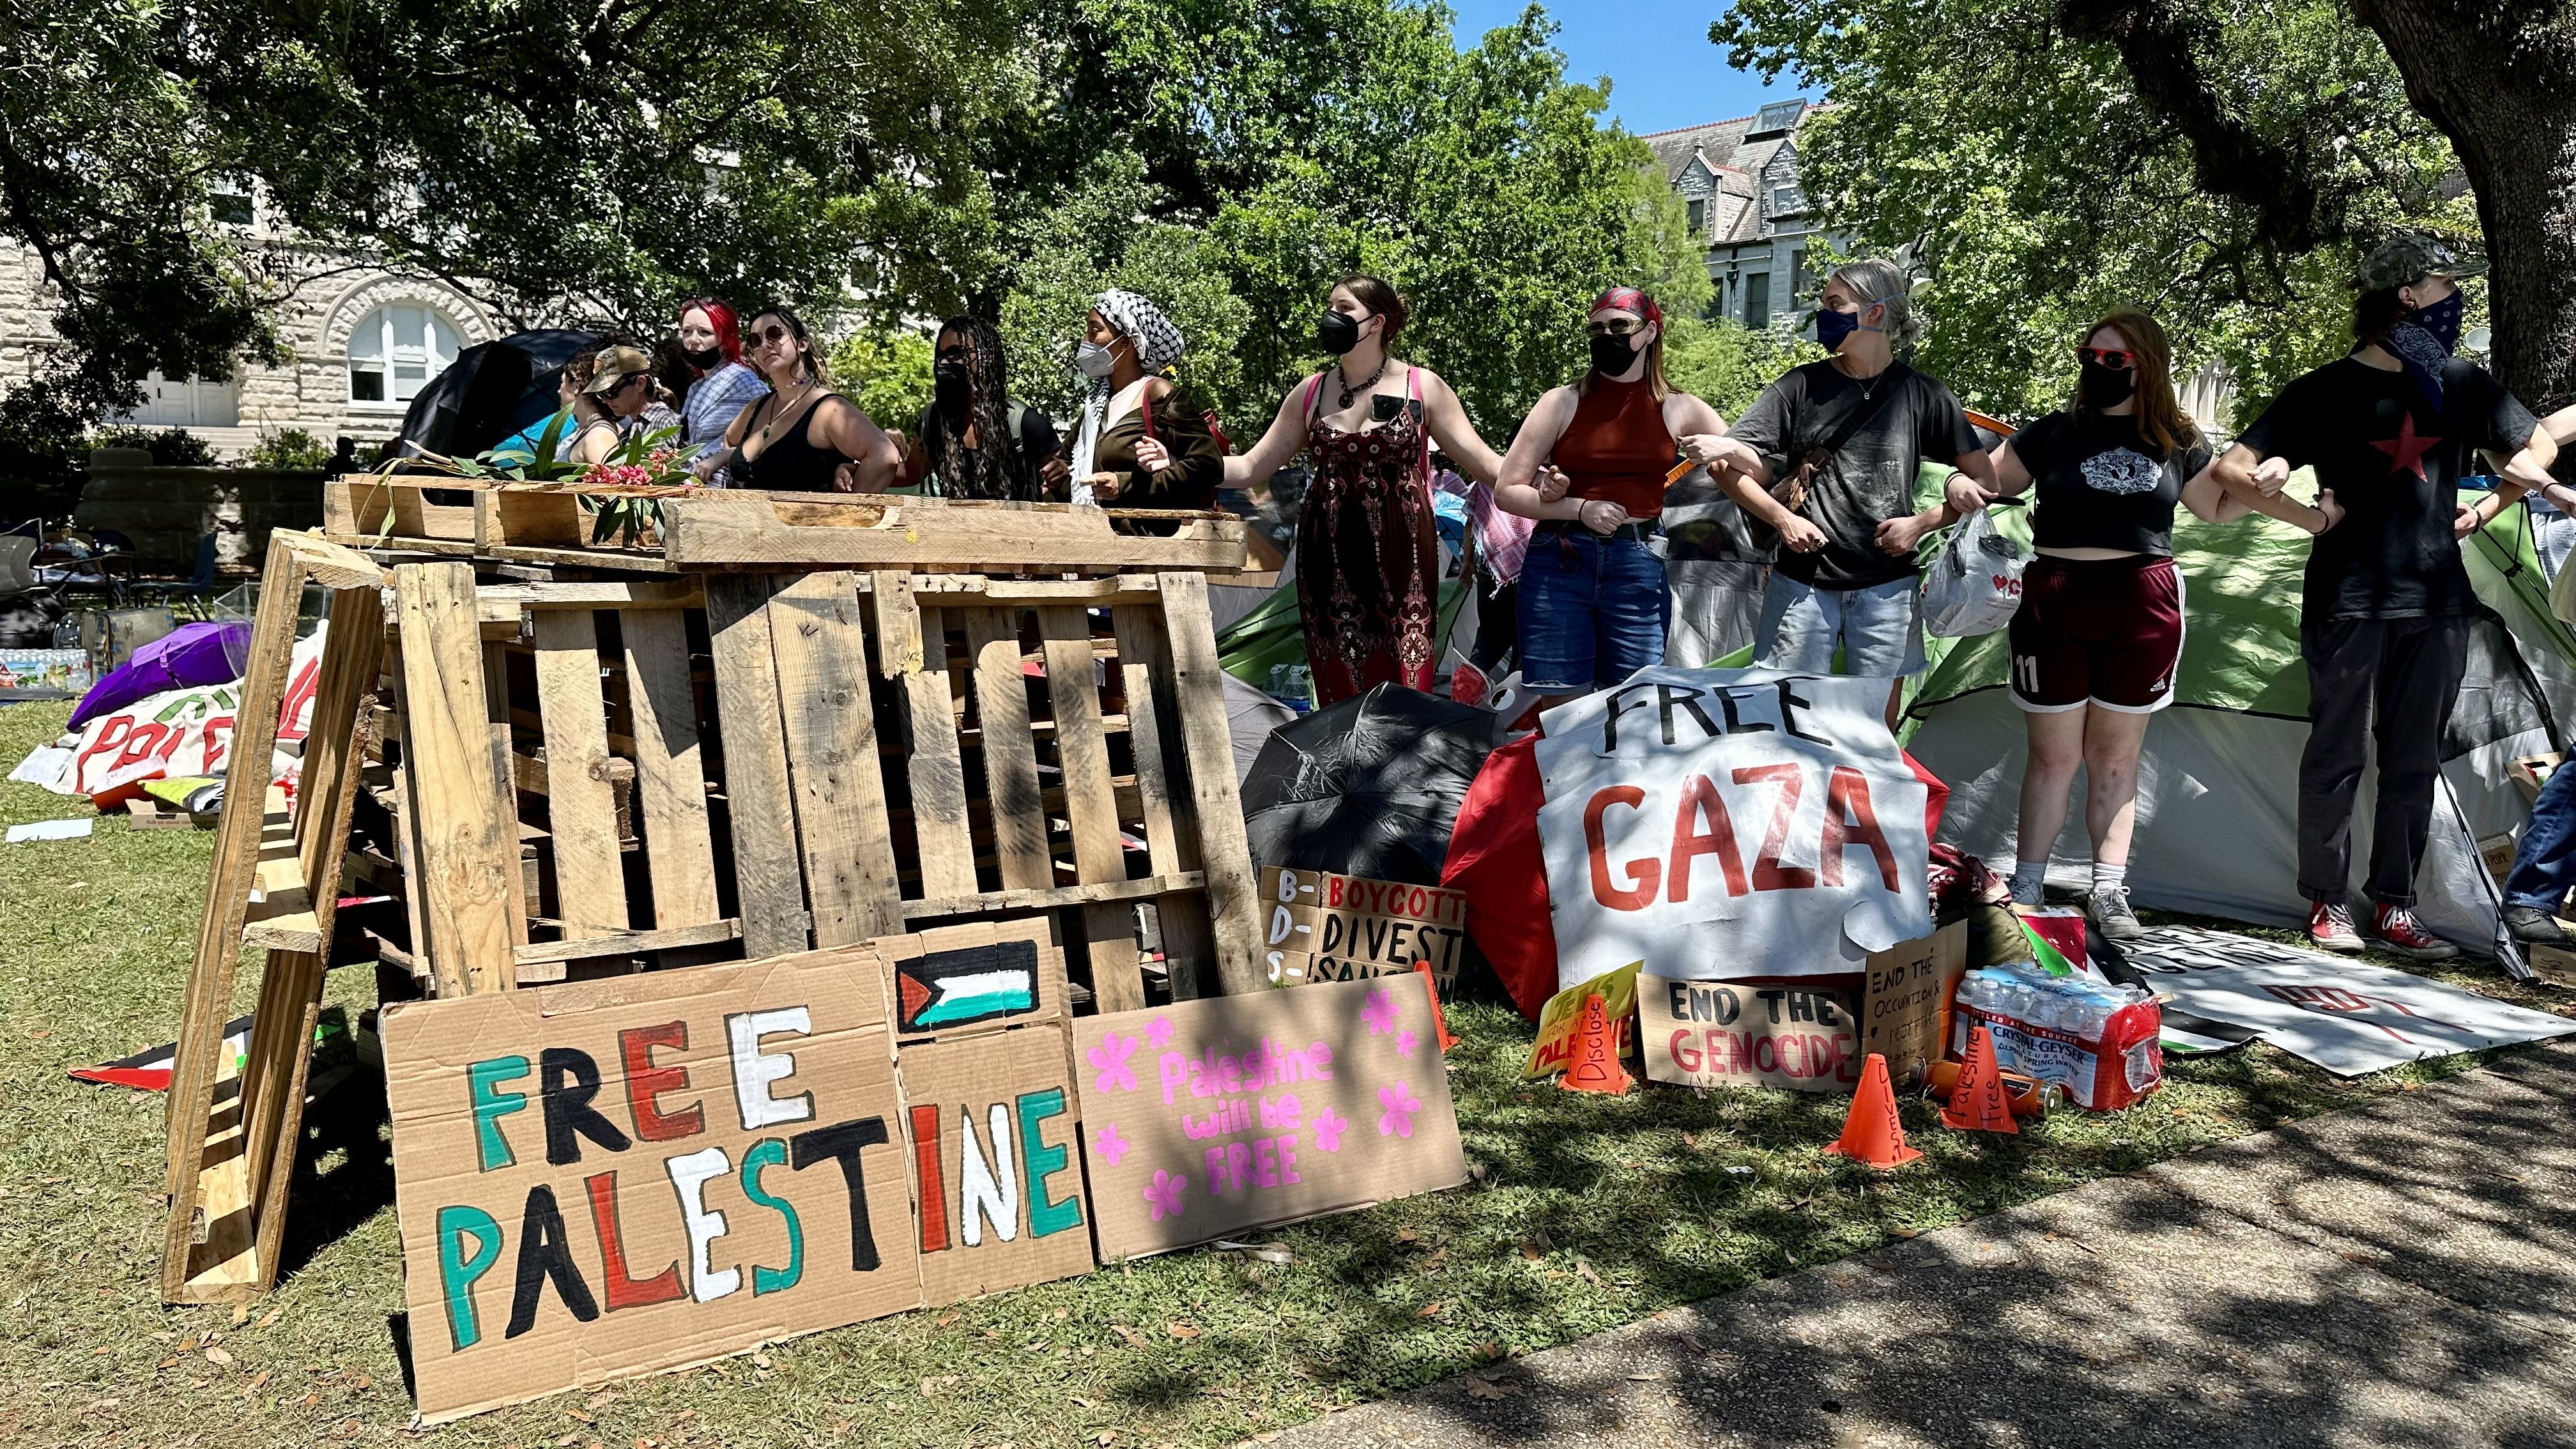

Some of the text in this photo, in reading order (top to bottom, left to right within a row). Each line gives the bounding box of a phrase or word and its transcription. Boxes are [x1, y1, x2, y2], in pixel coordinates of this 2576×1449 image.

[2016, 654, 2040, 693] 11
[1604, 676, 1834, 753] FREE
[1584, 763, 1901, 912] GAZA
[1330, 877, 1466, 923] BOYCOTT
[1322, 914, 1462, 972] DIVEST
[1873, 956, 1934, 994] END THE
[1547, 976, 1614, 1027] JEWS
[1669, 982, 1841, 1027] END THE
[1874, 986, 1933, 1018] OCCUPATION
[1577, 1002, 1607, 1081] Disclose
[1669, 1029, 1859, 1083] GENOCIDE
[1993, 1026, 2084, 1065] CRYSTAL GEYSER
[2016, 1044, 2066, 1060] NATURAL
[2041, 1031, 2078, 1044] SOURCE
[466, 1004, 816, 1173] FREE
[1159, 1036, 1333, 1105] Palestine
[1949, 1031, 1981, 1117] Palestine
[2023, 1054, 2053, 1067] SPRING
[2055, 1060, 2080, 1077] WATER
[1183, 1093, 1302, 1140] will be
[1879, 1062, 1902, 1160] DIVEST
[1206, 1135, 1301, 1195] FREE
[436, 1085, 1084, 1353] PALESTINE
